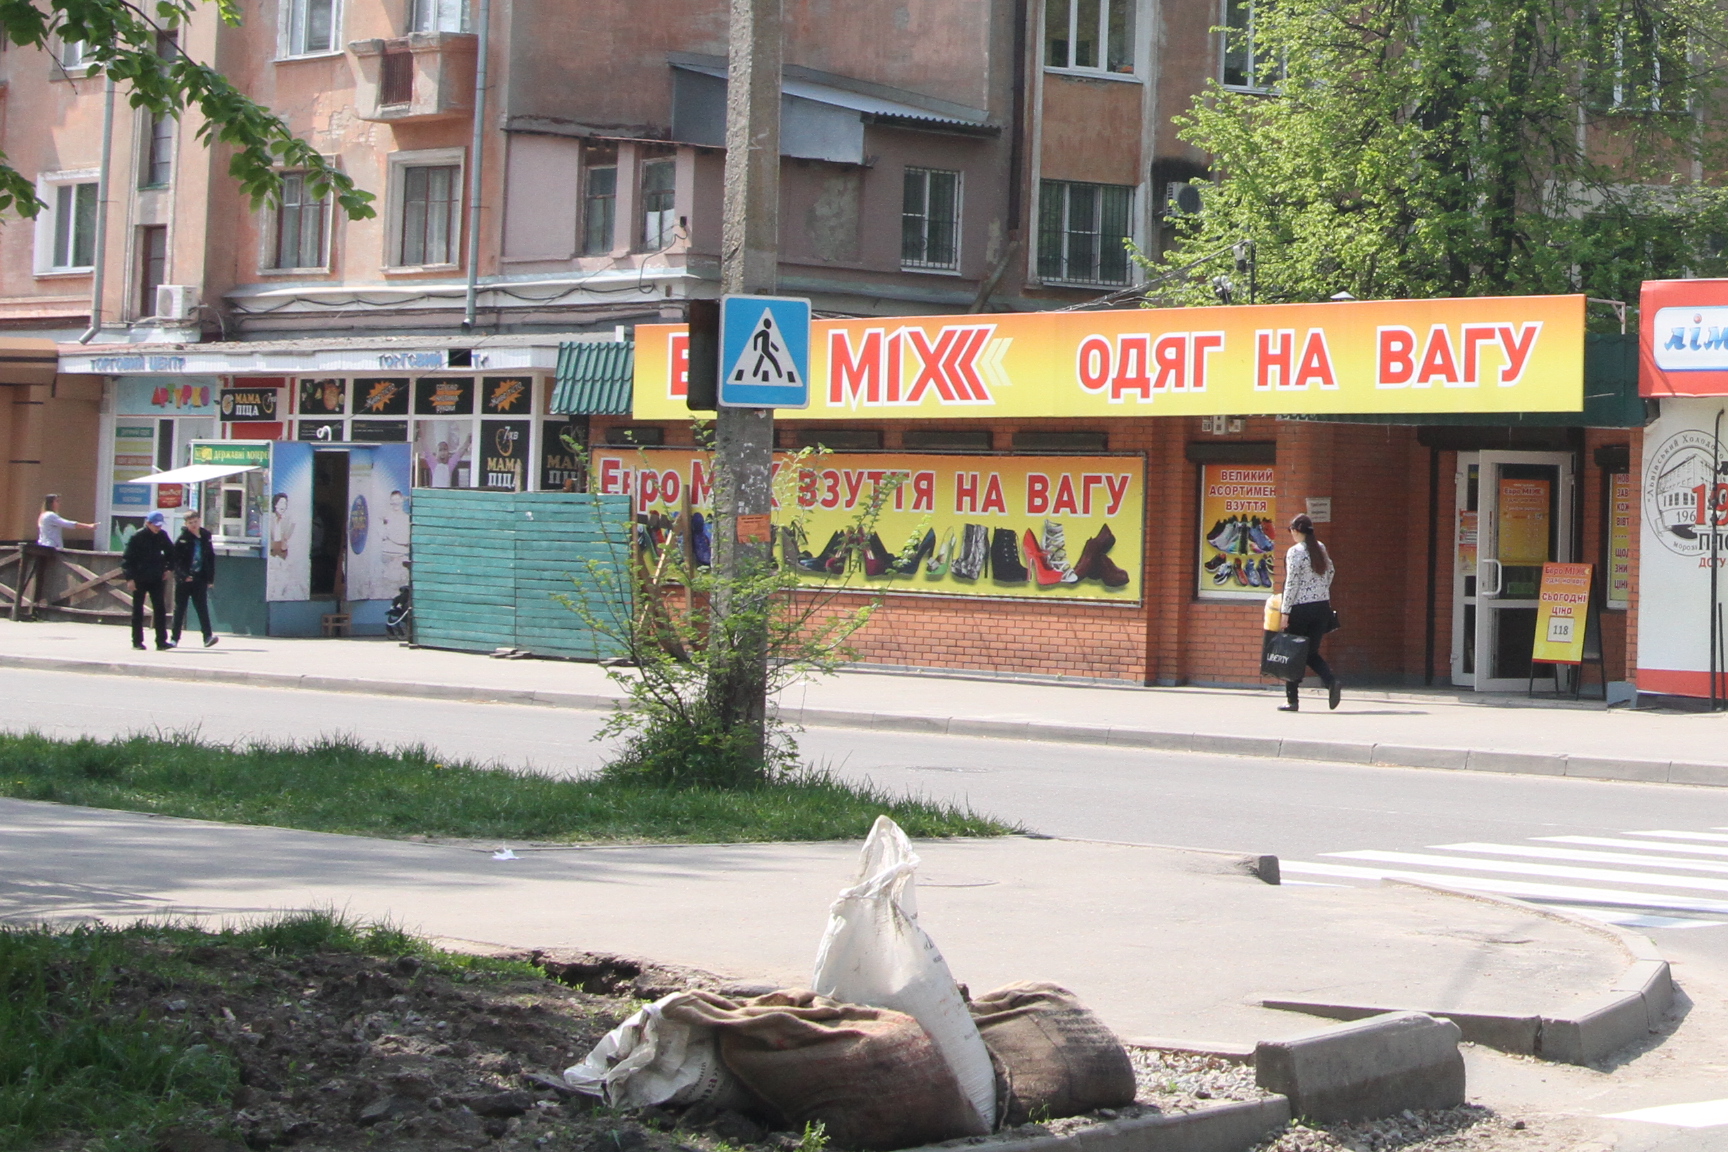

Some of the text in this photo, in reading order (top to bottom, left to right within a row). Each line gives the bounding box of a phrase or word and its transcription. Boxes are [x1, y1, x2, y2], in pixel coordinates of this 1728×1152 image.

[91, 356, 146, 371] ТОРГОВИЙ
[378, 351, 443, 369] ТОРГОВИЙ
[1076, 321, 1543, 403] ОДЯГ НА ВАГУ
[235, 393, 262, 404] МАМА
[235, 404, 260, 417] ПІЦА
[1221, 468, 1274, 482] ВЕЛИКИЙ
[797, 468, 935, 513] ВЗУТТЯ
[954, 471, 1008, 516] НА
[1025, 472, 1132, 517] ВАГУ
[1225, 500, 1267, 512] ВЗУТТЯ
[1553, 625, 1569, 636] 118
